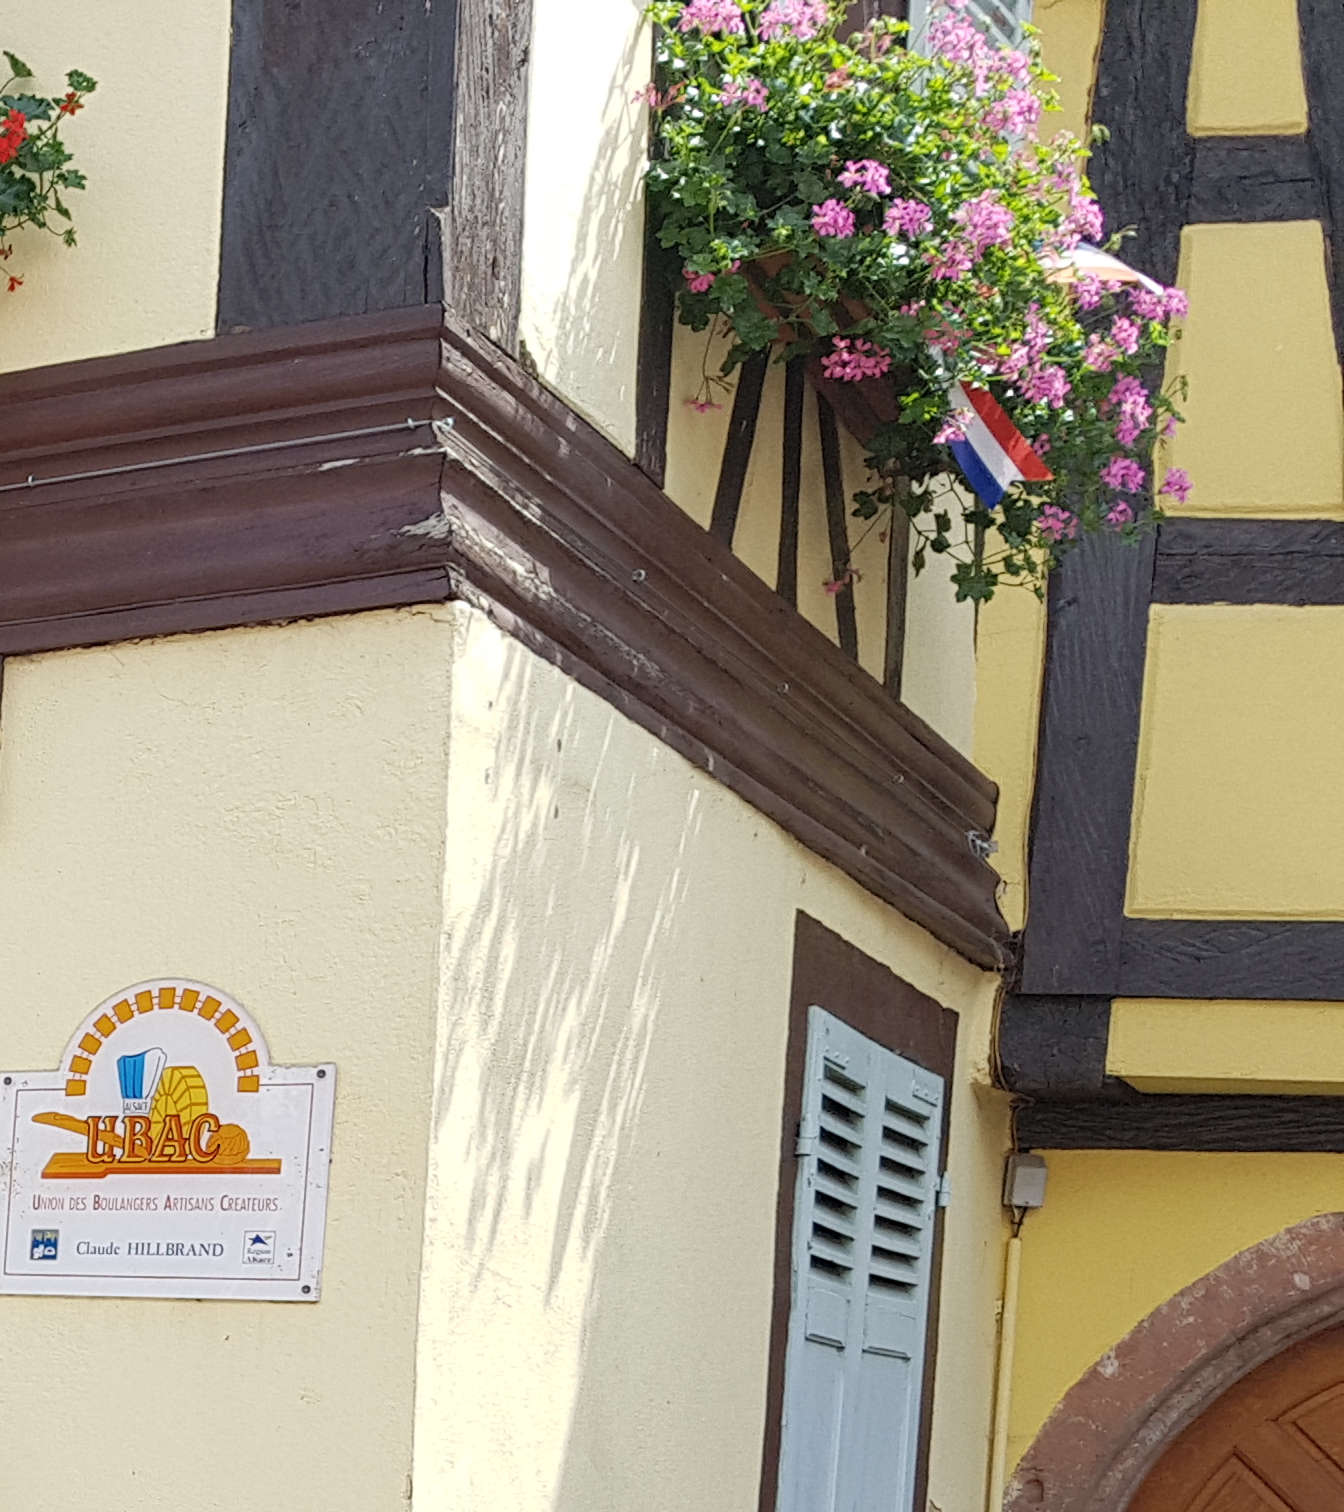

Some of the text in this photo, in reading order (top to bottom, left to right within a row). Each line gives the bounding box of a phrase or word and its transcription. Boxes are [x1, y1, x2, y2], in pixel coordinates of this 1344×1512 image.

[86, 1112, 221, 1164] UBAC
[69, 1196, 87, 1211] DES
[92, 1194, 158, 1211] BOULANGERS
[163, 1194, 214, 1211] ARTISANS
[76, 1241, 224, 1257] Claude HILLBRAND
